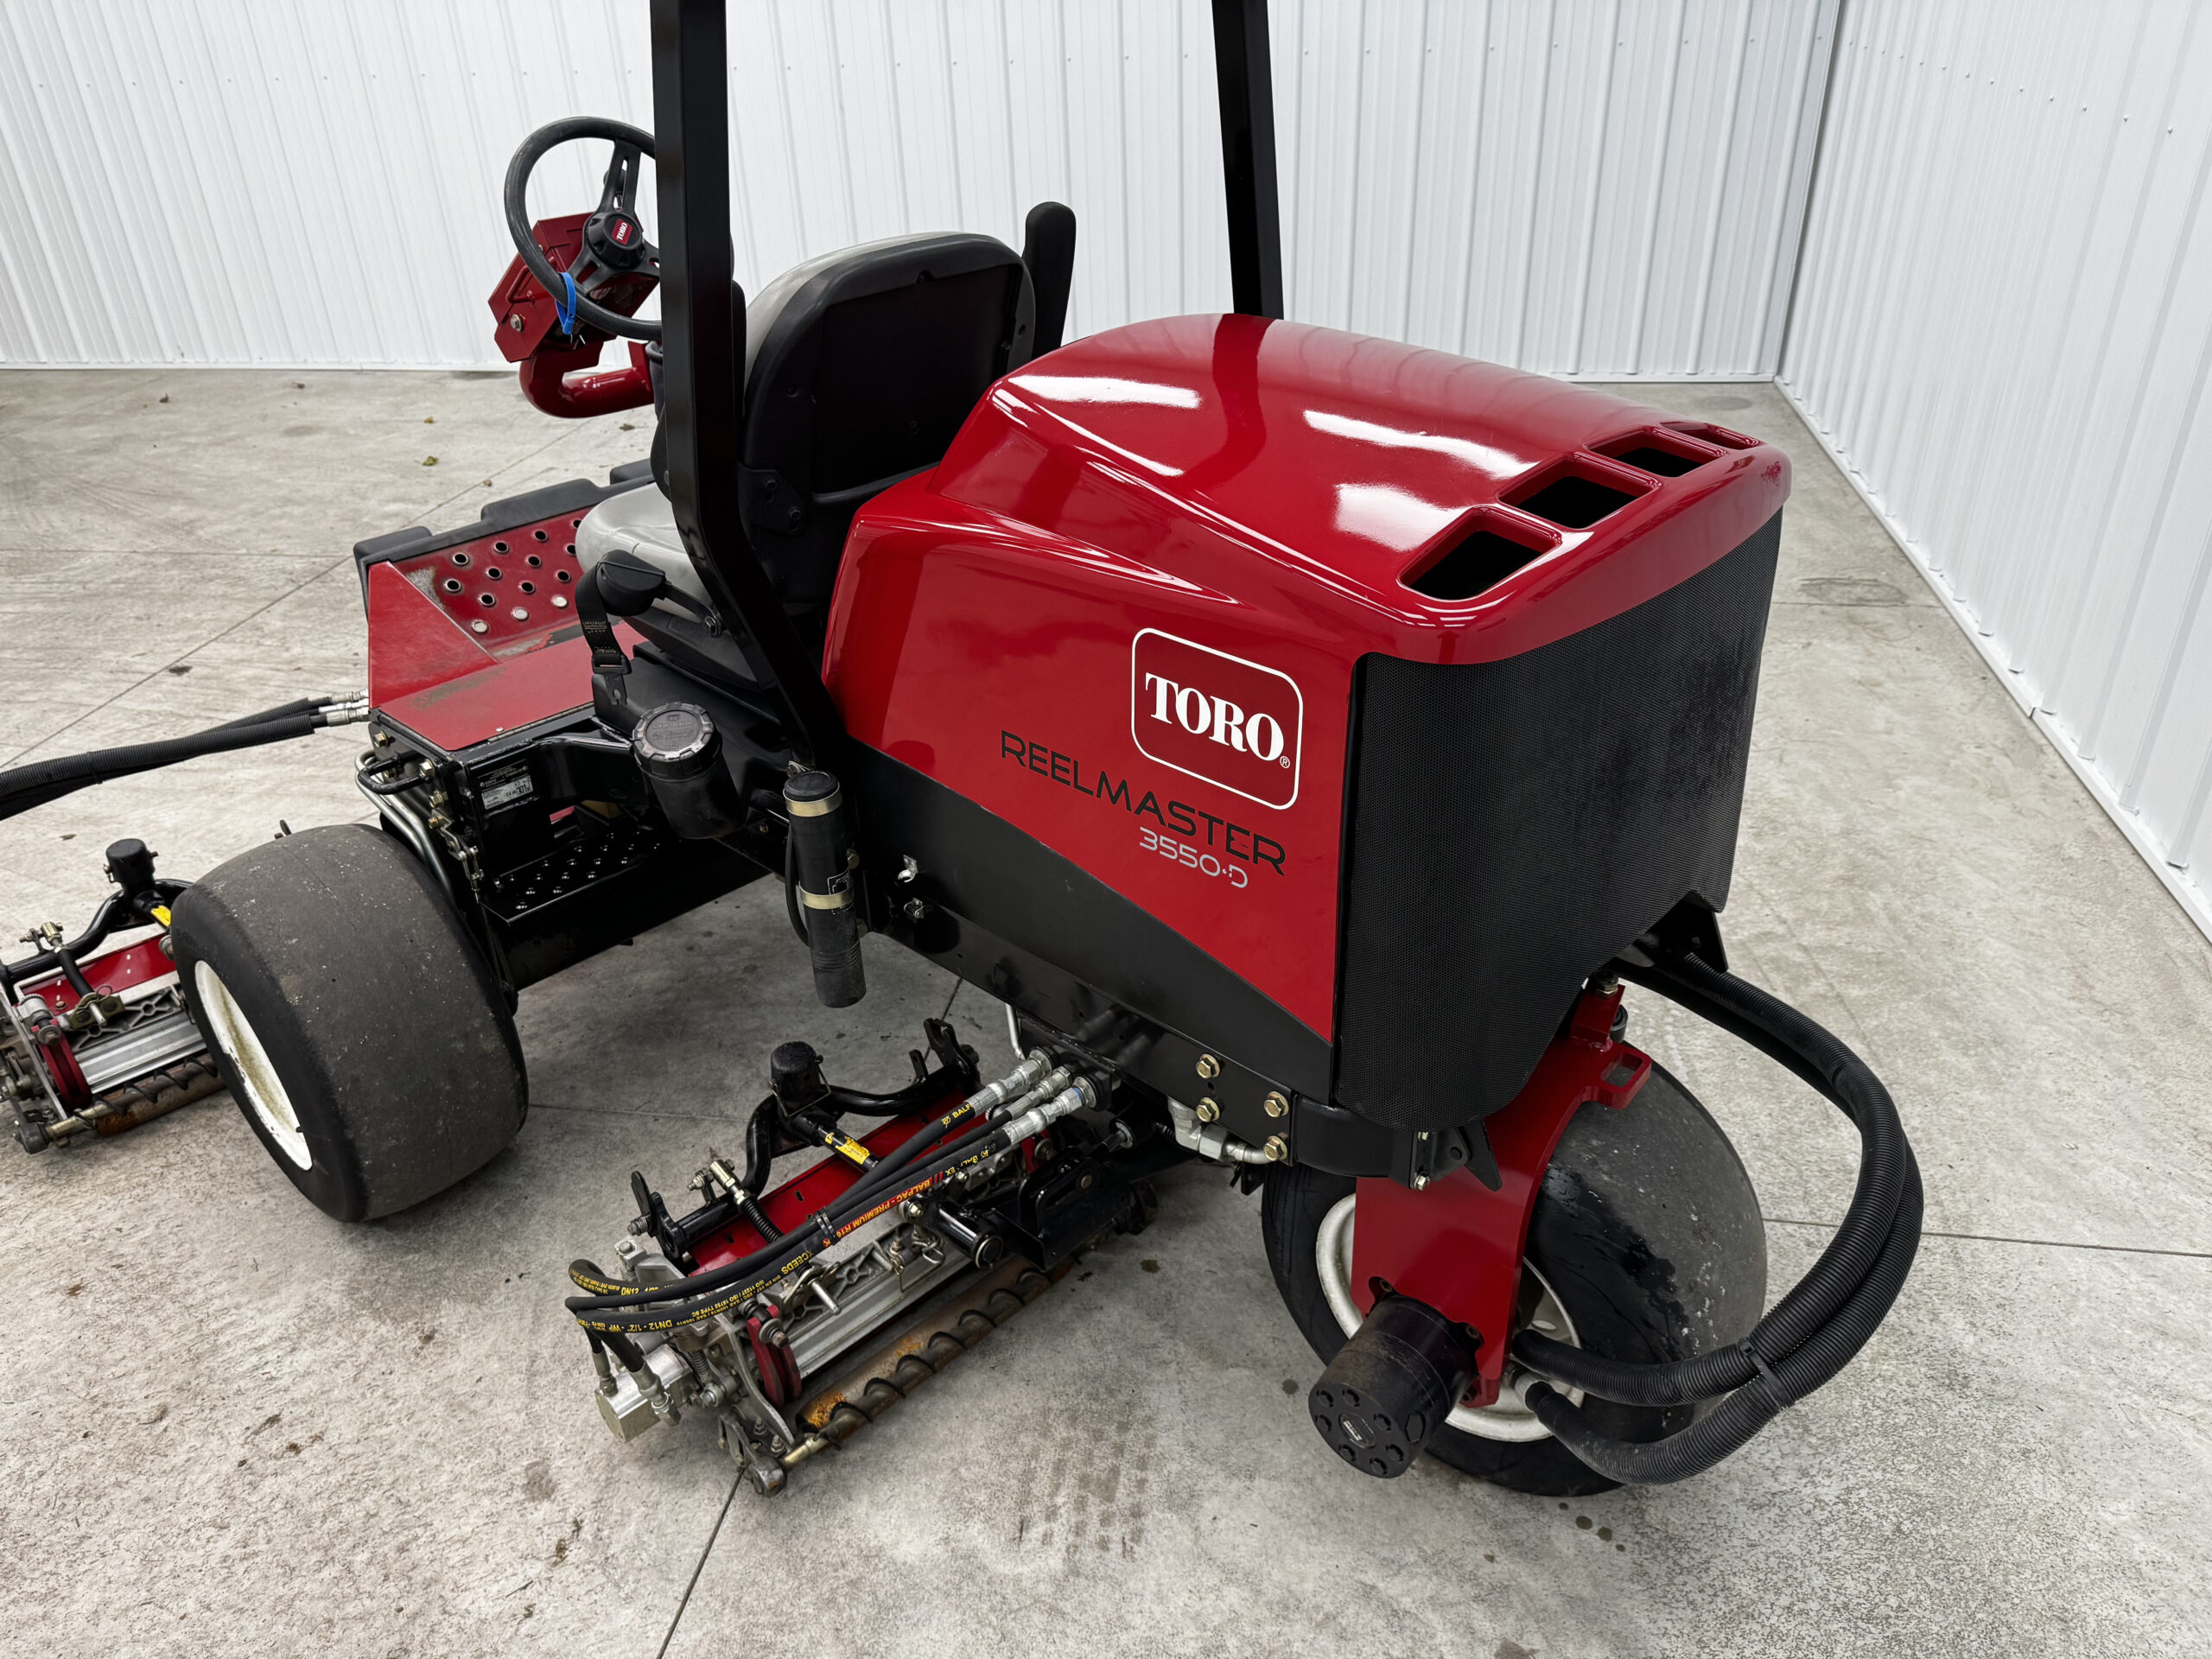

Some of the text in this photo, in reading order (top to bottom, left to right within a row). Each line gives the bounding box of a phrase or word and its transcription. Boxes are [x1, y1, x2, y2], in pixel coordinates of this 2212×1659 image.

[616, 222, 628, 240] TORO
[1001, 729, 1287, 876] REELMASTER
[952, 1103, 972, 1119] BALF
[897, 1179, 931, 1203] BALPAC
[853, 1202, 891, 1228] PREMIUM
[649, 1319, 672, 1331] DN12
